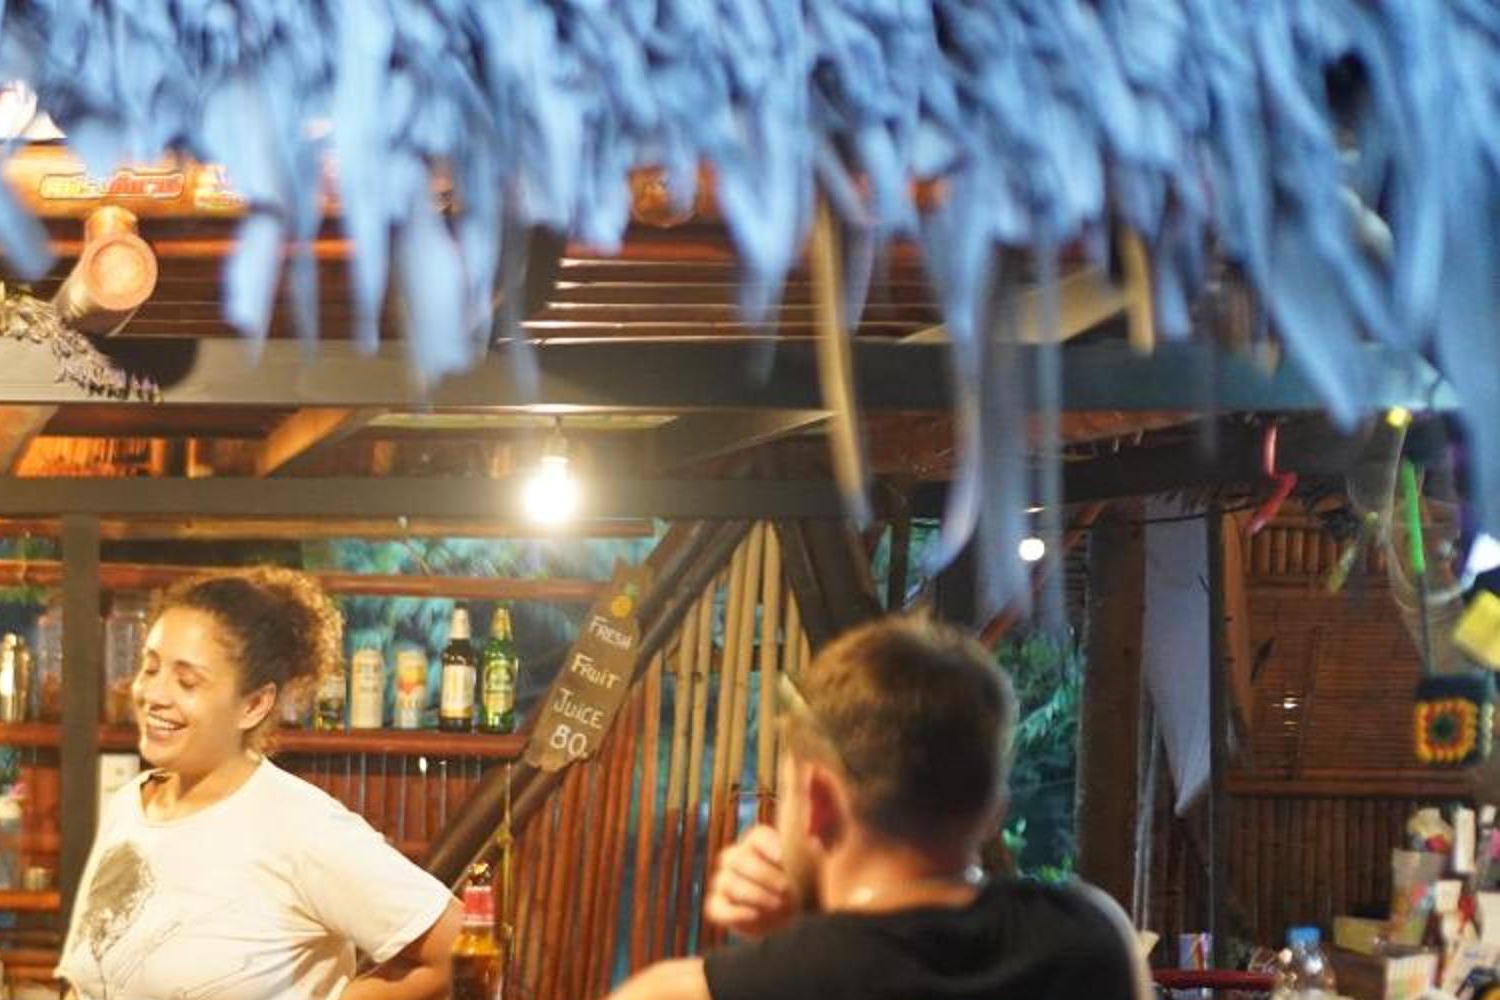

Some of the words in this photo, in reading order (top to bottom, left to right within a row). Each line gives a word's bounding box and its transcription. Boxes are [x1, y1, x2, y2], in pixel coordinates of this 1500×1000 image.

[589, 615, 633, 650] FRESH
[571, 652, 621, 688] FRUIT
[553, 688, 604, 729] JUICE
